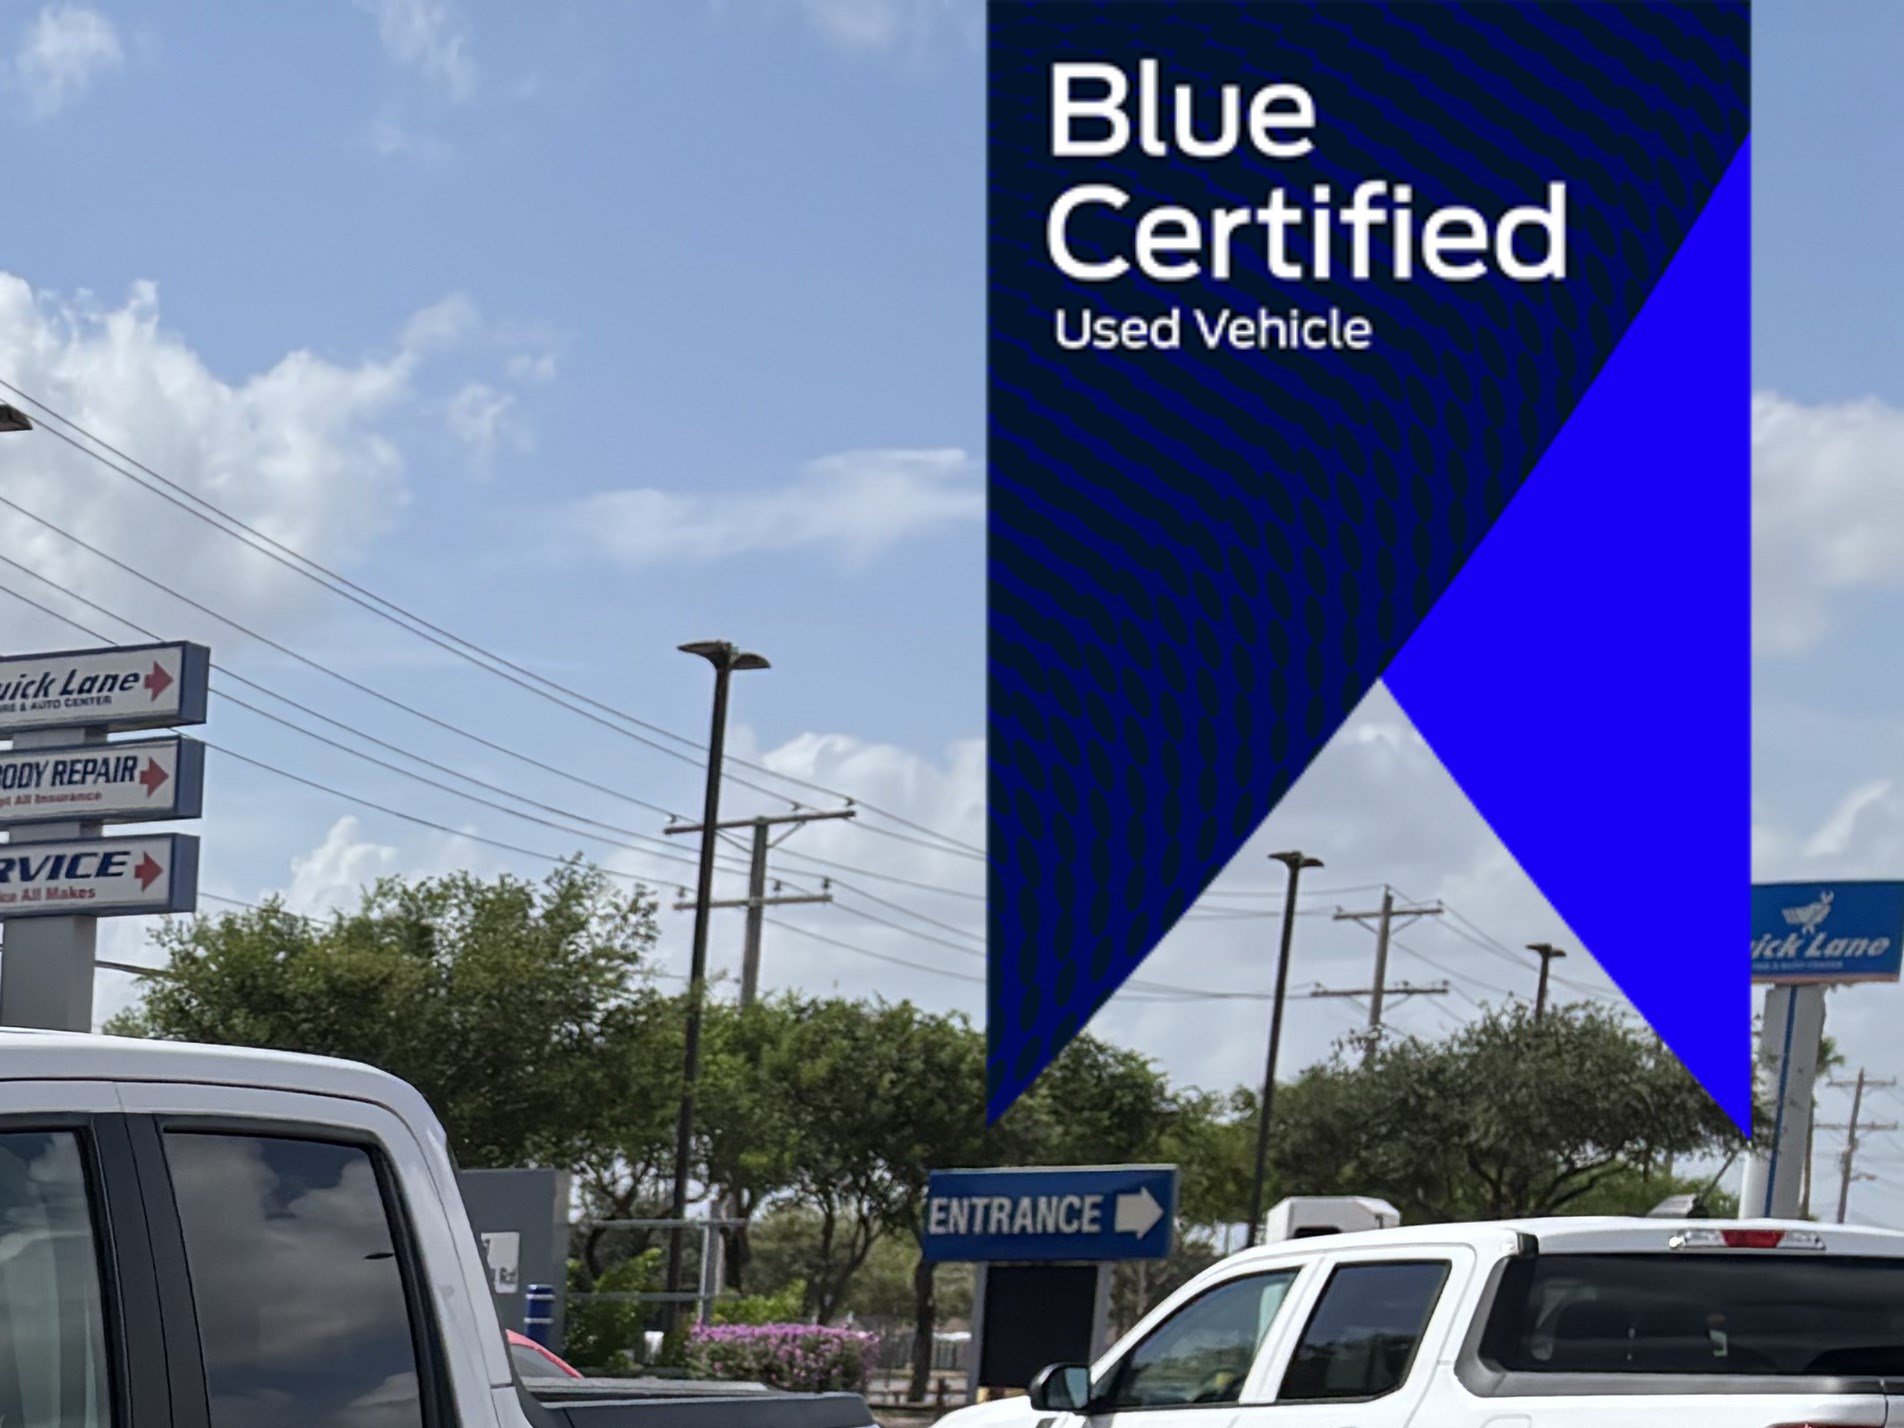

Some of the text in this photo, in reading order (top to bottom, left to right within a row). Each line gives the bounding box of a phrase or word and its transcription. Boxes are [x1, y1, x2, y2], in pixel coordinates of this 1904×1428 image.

[59, 668, 140, 696] Lane
[51, 755, 138, 786] REPAIR
[46, 885, 96, 900] Makes
[1751, 932, 1890, 959] ick Lane
[928, 1194, 1104, 1236] ENTRANCE
